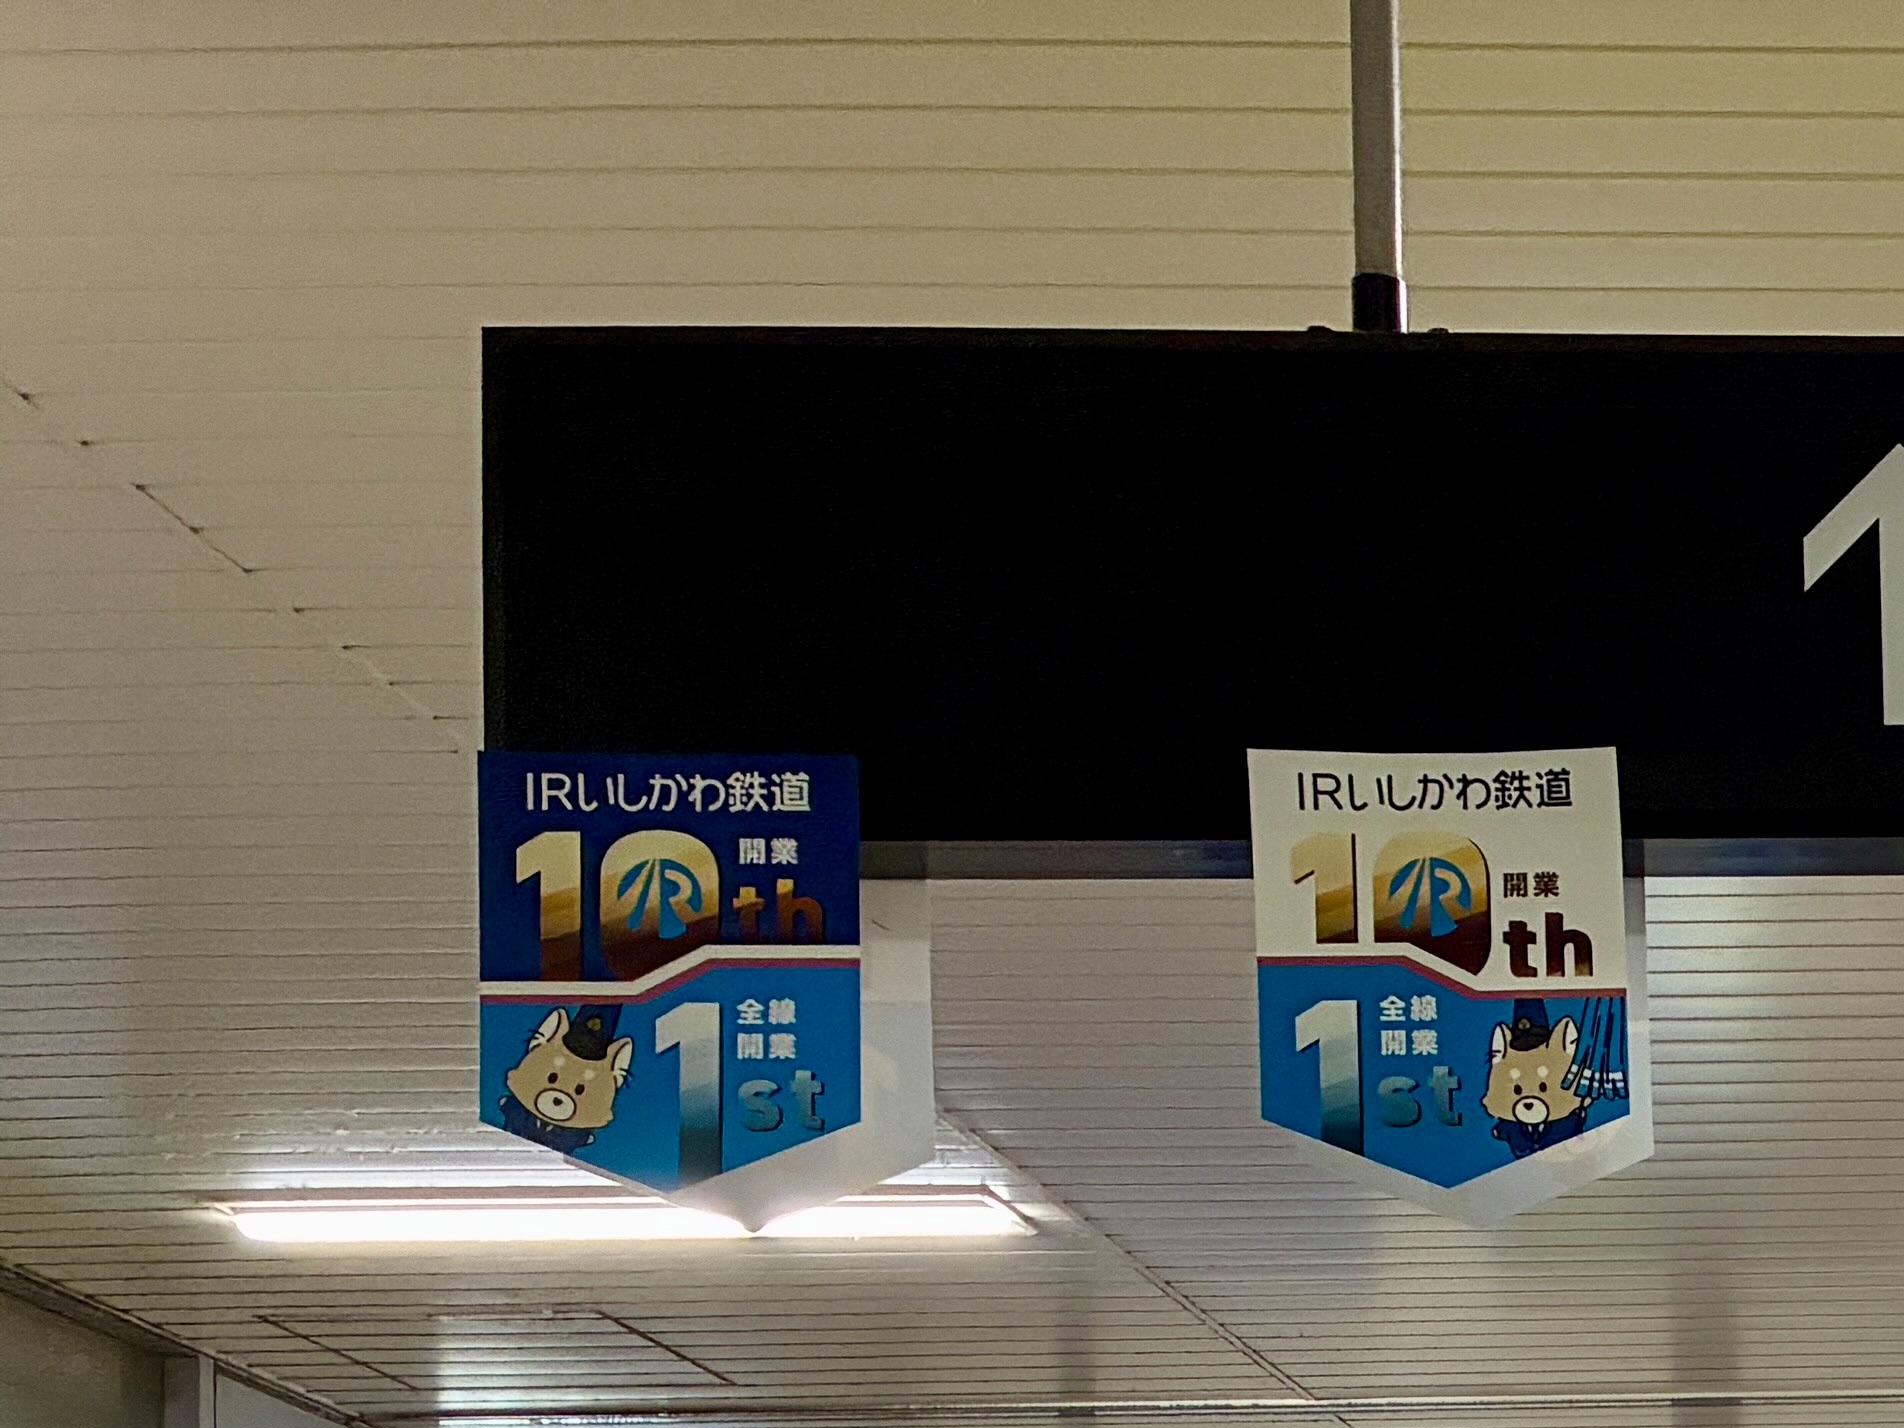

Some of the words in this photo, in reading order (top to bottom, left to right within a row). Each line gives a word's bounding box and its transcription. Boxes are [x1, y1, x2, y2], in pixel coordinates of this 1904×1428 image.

[527, 772, 811, 814] IRいしかわ鉄道
[1298, 768, 1574, 812] IRいしかわ鉄道
[739, 838, 799, 867] 開業
[1504, 872, 1561, 898] 開業
